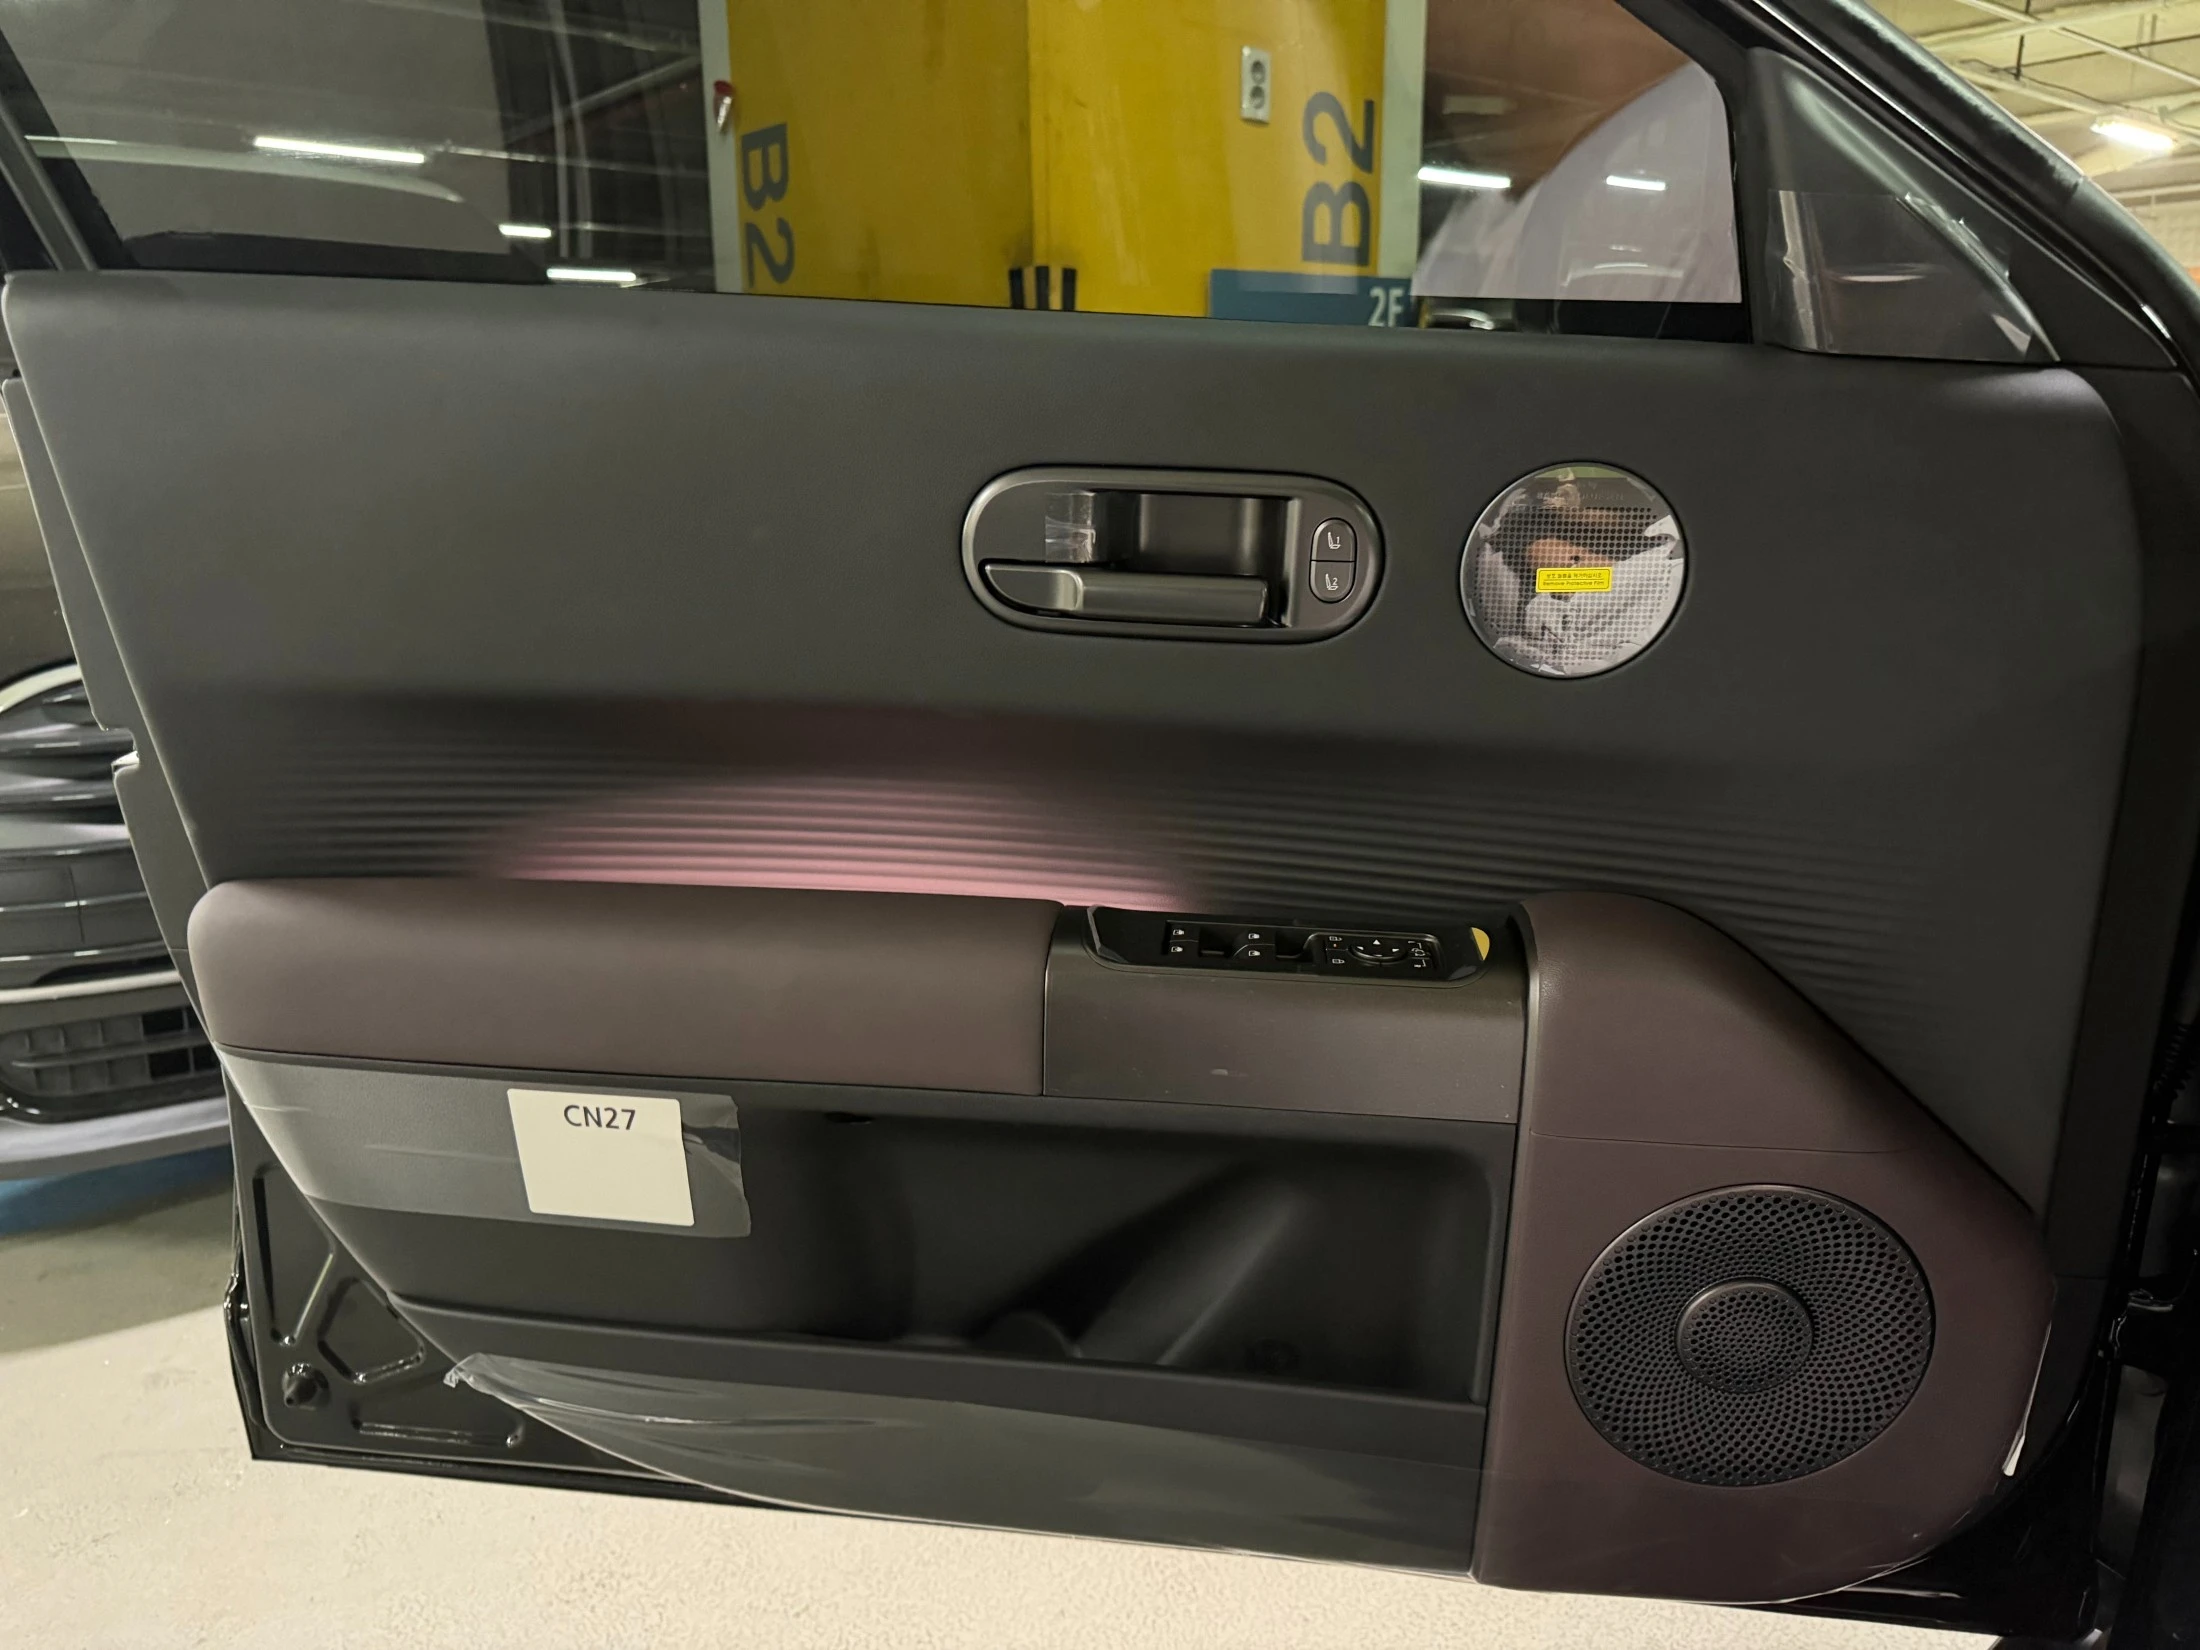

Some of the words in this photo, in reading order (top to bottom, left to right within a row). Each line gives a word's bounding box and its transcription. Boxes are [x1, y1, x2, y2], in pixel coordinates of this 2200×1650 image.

[1303, 92, 1374, 265] B2
[741, 123, 795, 287] B2
[1368, 286, 1404, 328] 2F
[1332, 577, 1338, 586] 2
[563, 1104, 636, 1130] CN27
